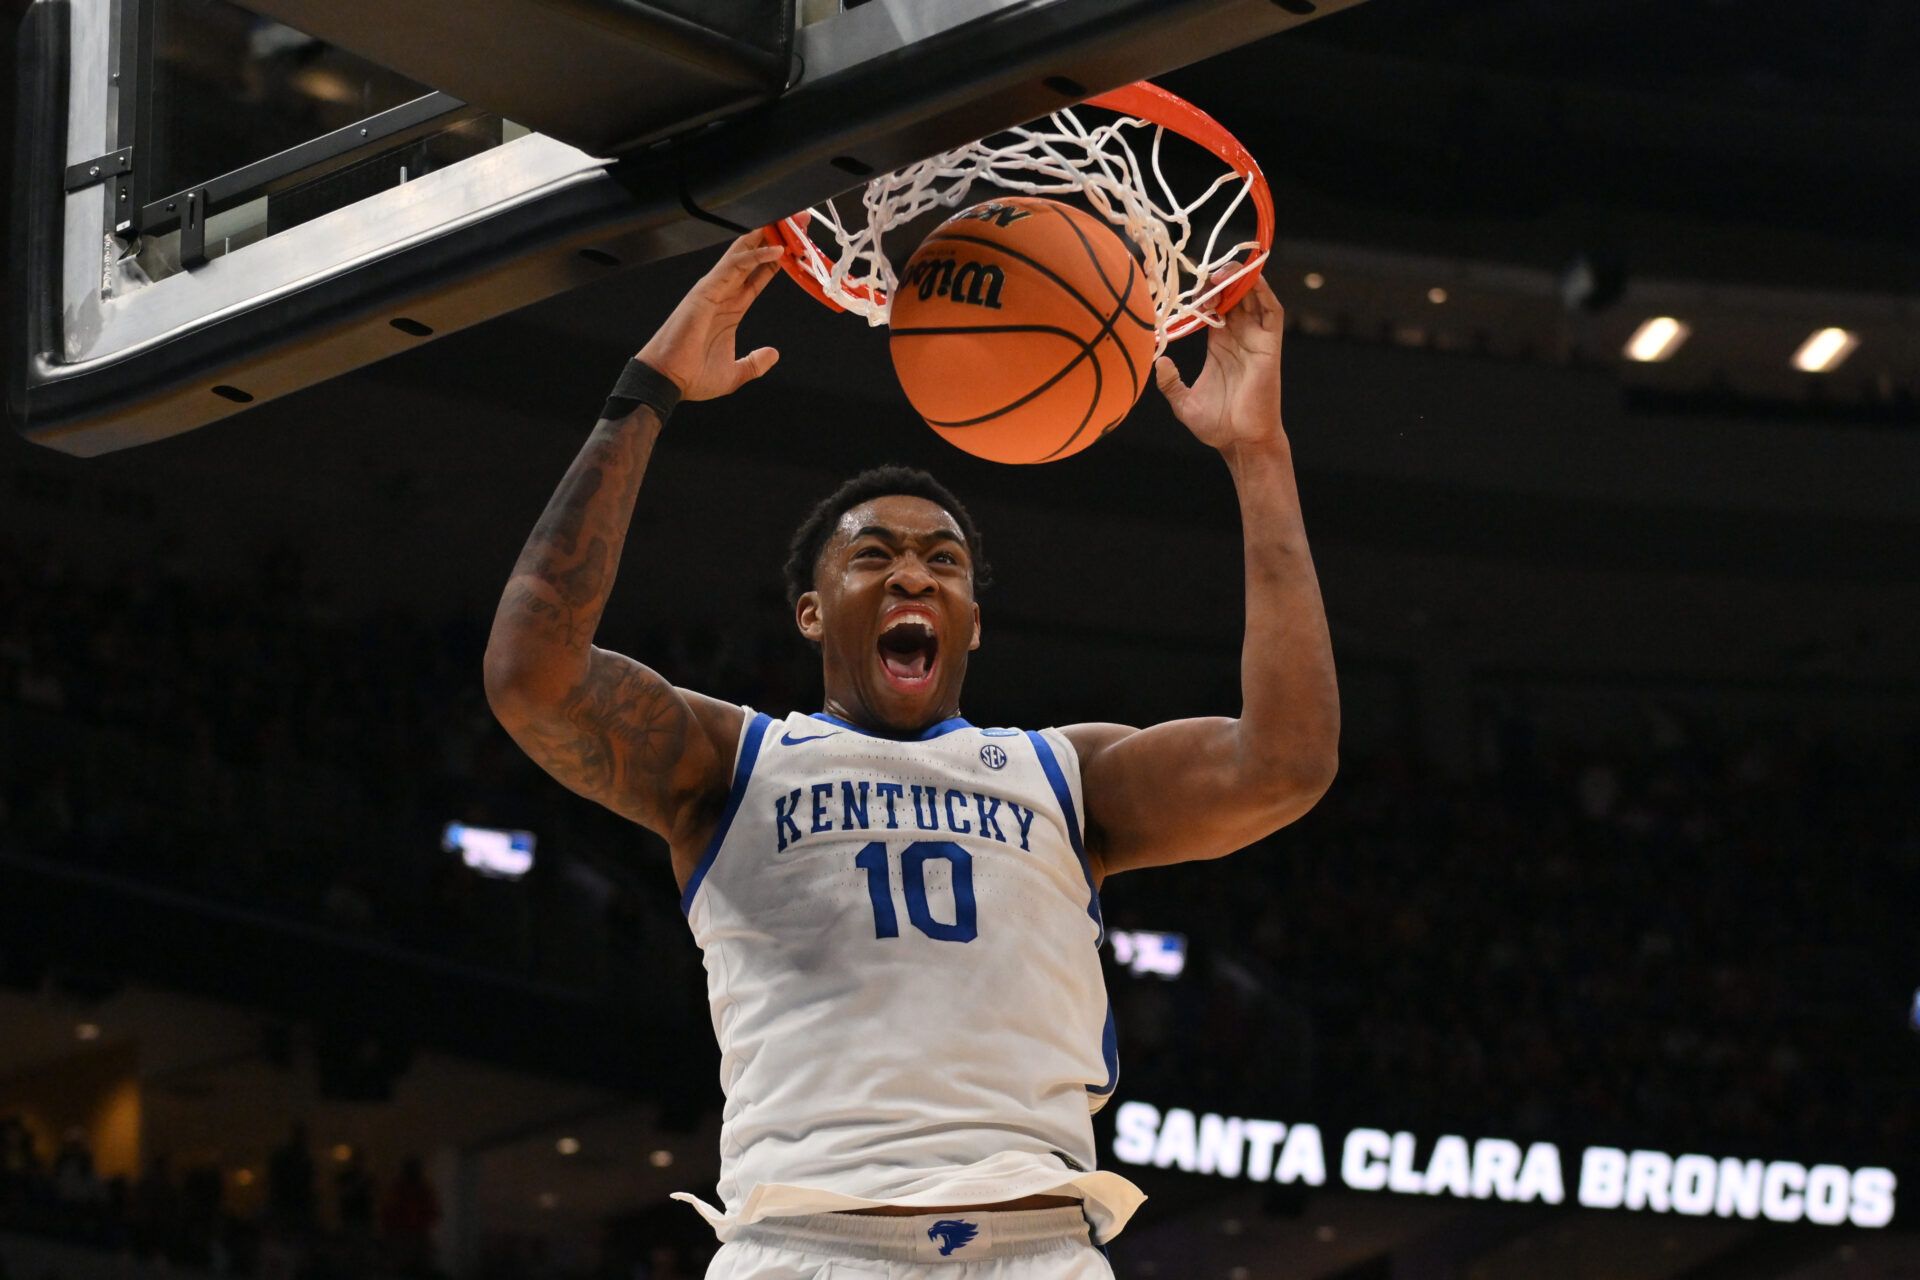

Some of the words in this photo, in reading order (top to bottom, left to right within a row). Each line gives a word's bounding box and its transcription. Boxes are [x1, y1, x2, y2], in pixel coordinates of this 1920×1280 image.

[981, 745, 1006, 767] SEC
[775, 781, 1034, 853] KENTUCKY
[855, 841, 978, 943] 10
[1113, 1101, 1326, 1186] SANTA
[1341, 1128, 1565, 1205] CLARA
[1578, 1146, 1897, 1228] BRONCOS
